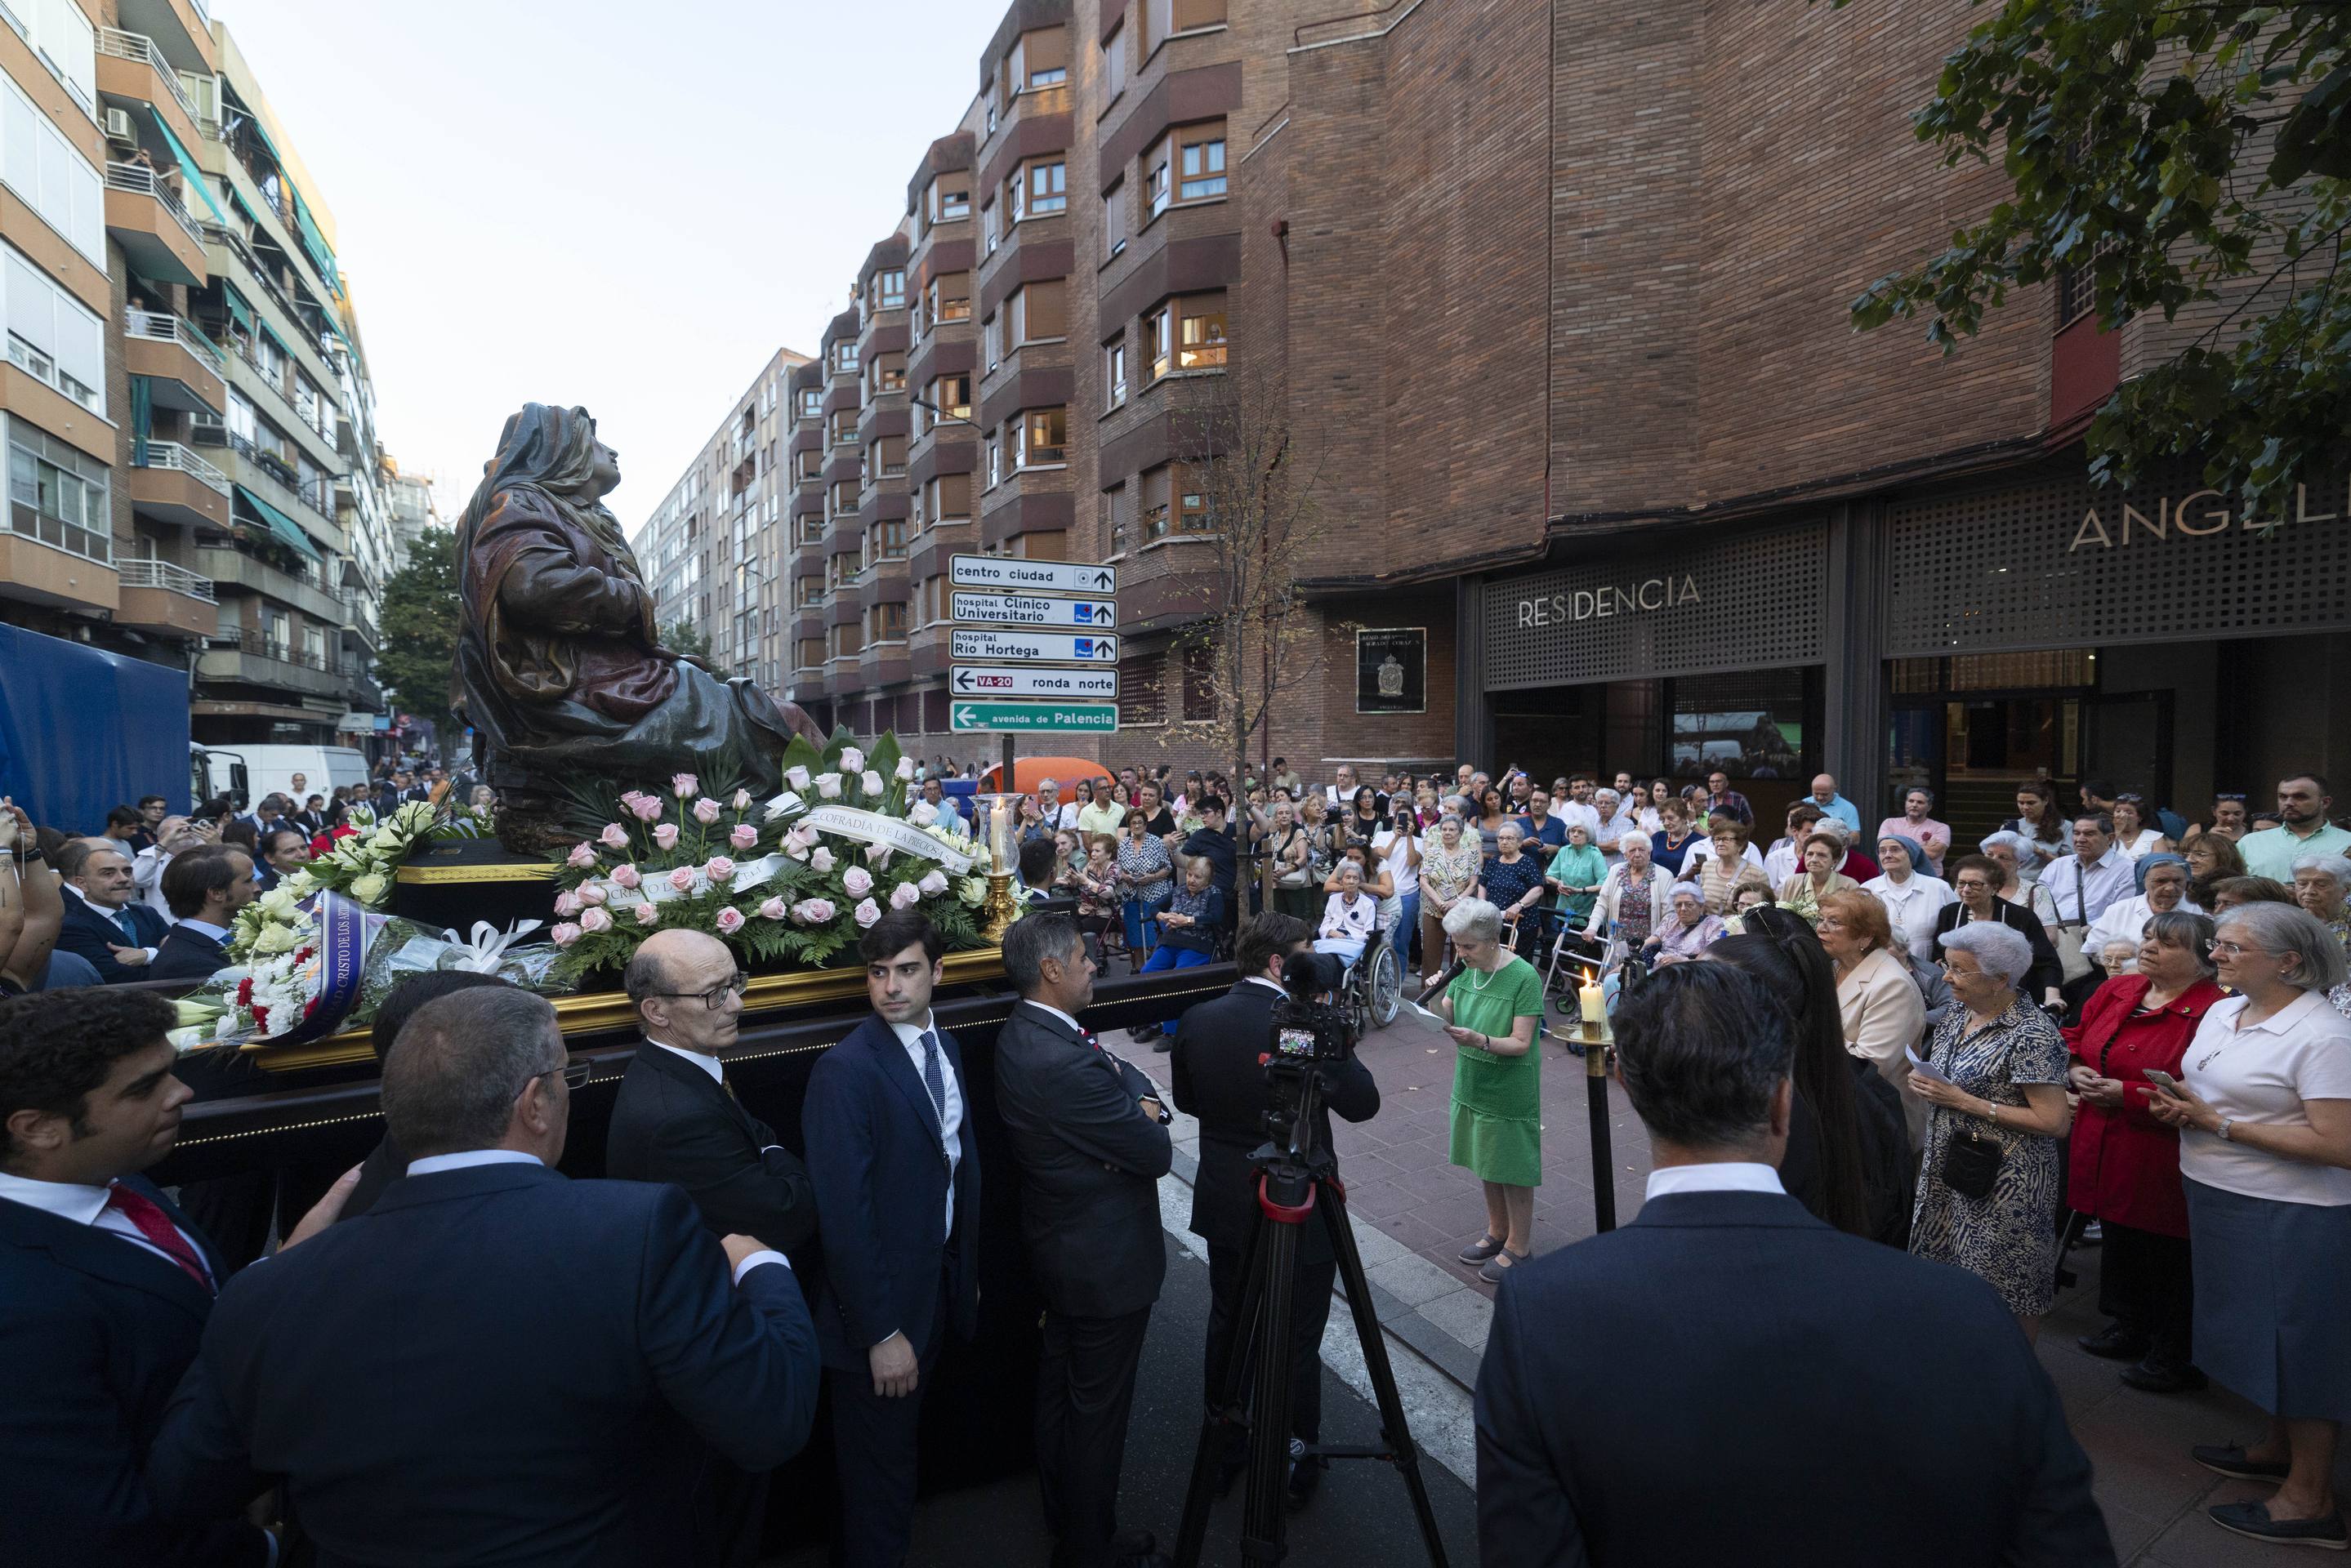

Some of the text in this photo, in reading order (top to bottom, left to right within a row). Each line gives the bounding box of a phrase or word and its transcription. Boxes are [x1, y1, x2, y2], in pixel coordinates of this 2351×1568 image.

[957, 567, 1053, 581] centro ciudad
[957, 597, 1050, 610] hospital Clínico
[1519, 573, 1701, 628] RESIDENCIA
[957, 607, 1044, 621] Universitario
[955, 632, 997, 643] hospital
[985, 644, 1039, 657] Hortega
[978, 677, 1113, 689] VA-20 ronda norte
[992, 713, 1113, 724] avenida de Palencia
[819, 812, 872, 831] COFRADÍA
[877, 824, 892, 836] DE
[894, 830, 907, 843] LA
[908, 835, 944, 858] PRECIOSA
[610, 884, 659, 900] CRISTO
[337, 921, 350, 936] LOS
[337, 937, 350, 950] DE
[337, 950, 350, 987] CRISTO
